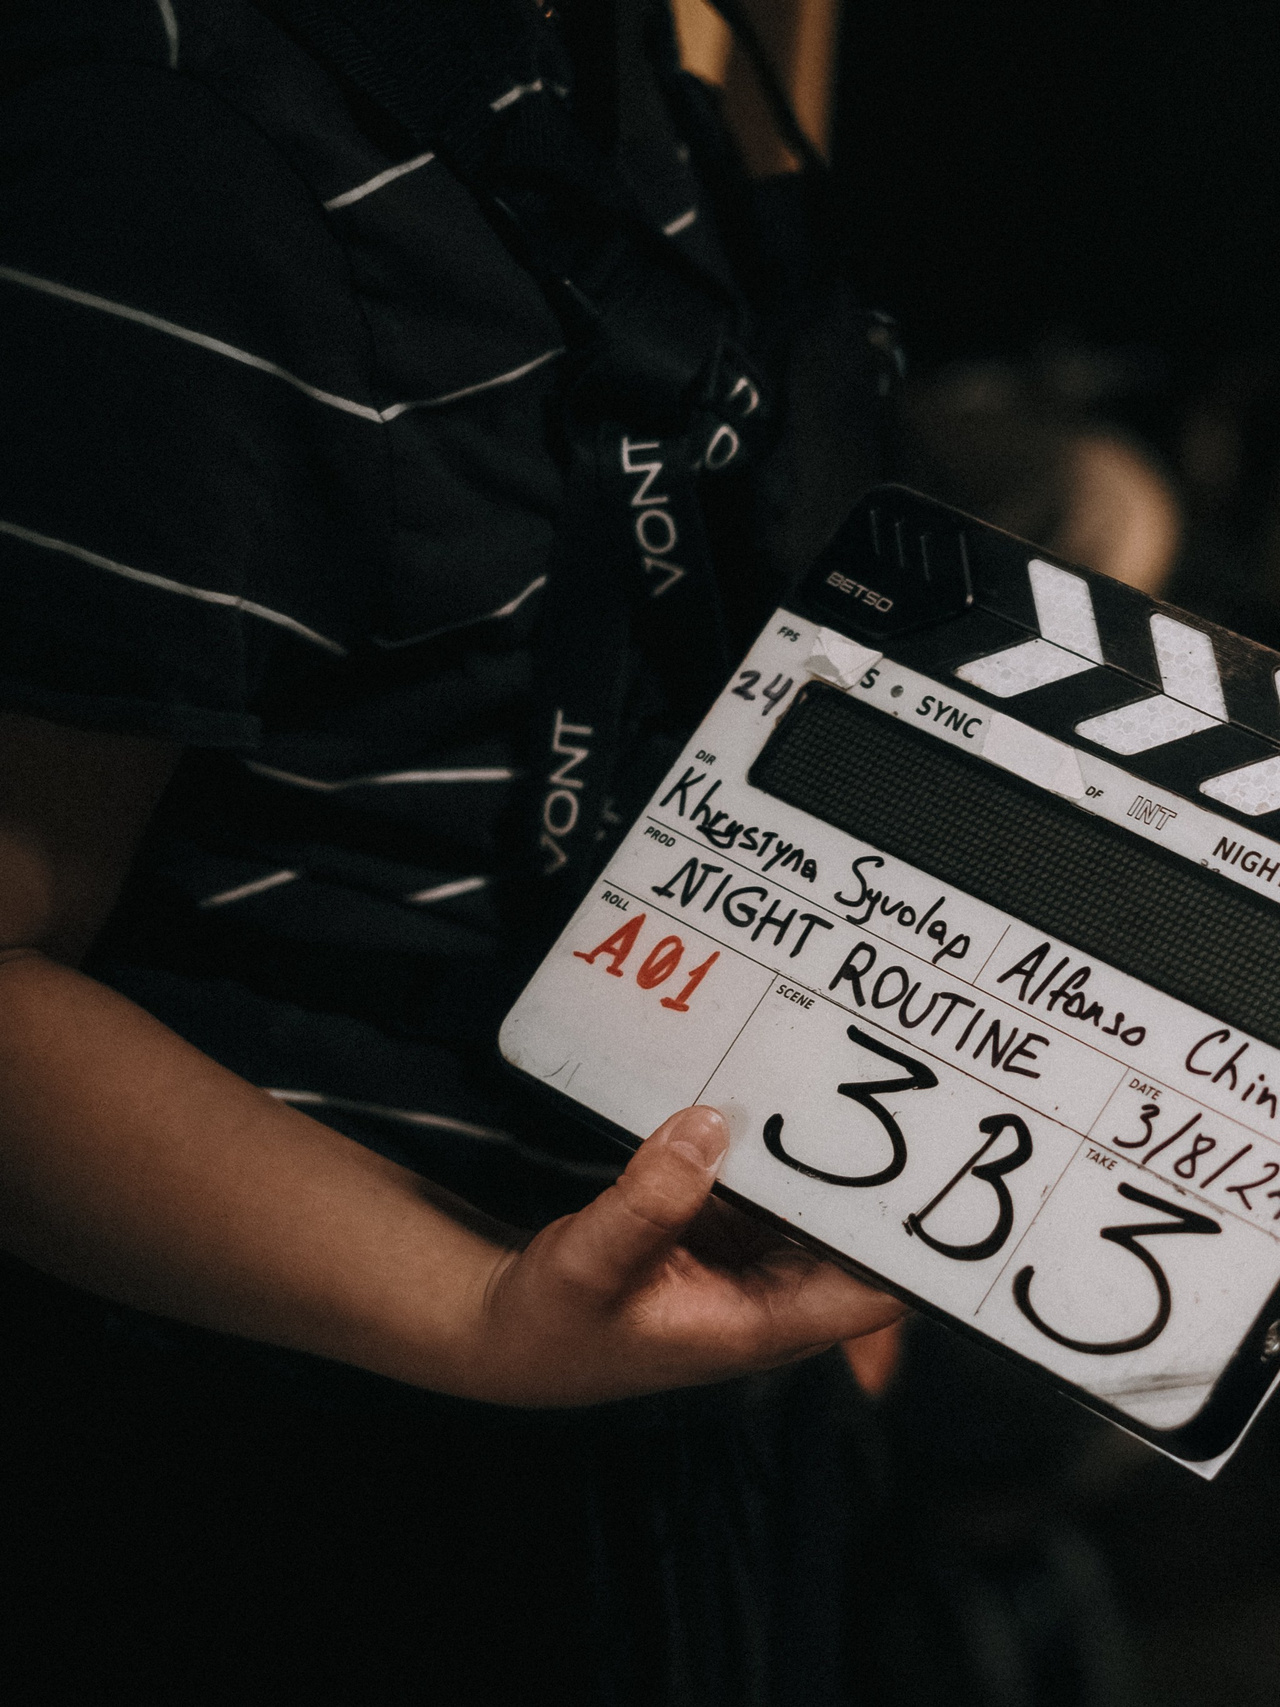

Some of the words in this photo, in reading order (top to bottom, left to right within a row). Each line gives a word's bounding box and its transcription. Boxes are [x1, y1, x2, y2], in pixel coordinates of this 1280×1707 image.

[620, 436, 686, 596] VONT
[826, 571, 893, 612] BETSO
[777, 626, 800, 642] FPS
[731, 670, 794, 716] 24
[915, 695, 983, 739] SYNC
[695, 750, 716, 765] DIR
[1126, 795, 1178, 831] INT
[644, 826, 676, 848] PROD
[602, 890, 629, 911] ROLL
[651, 857, 834, 958] NIGHT
[829, 941, 1050, 1079] ROUTINE
[776, 984, 815, 1010] SCENE
[997, 942, 1146, 1046] Alfonso
[1185, 1029, 1278, 1119] Chin
[1129, 1078, 1162, 1101] DATE
[1085, 1148, 1117, 1171] TAKE
[1012, 1182, 1223, 1355] 3
